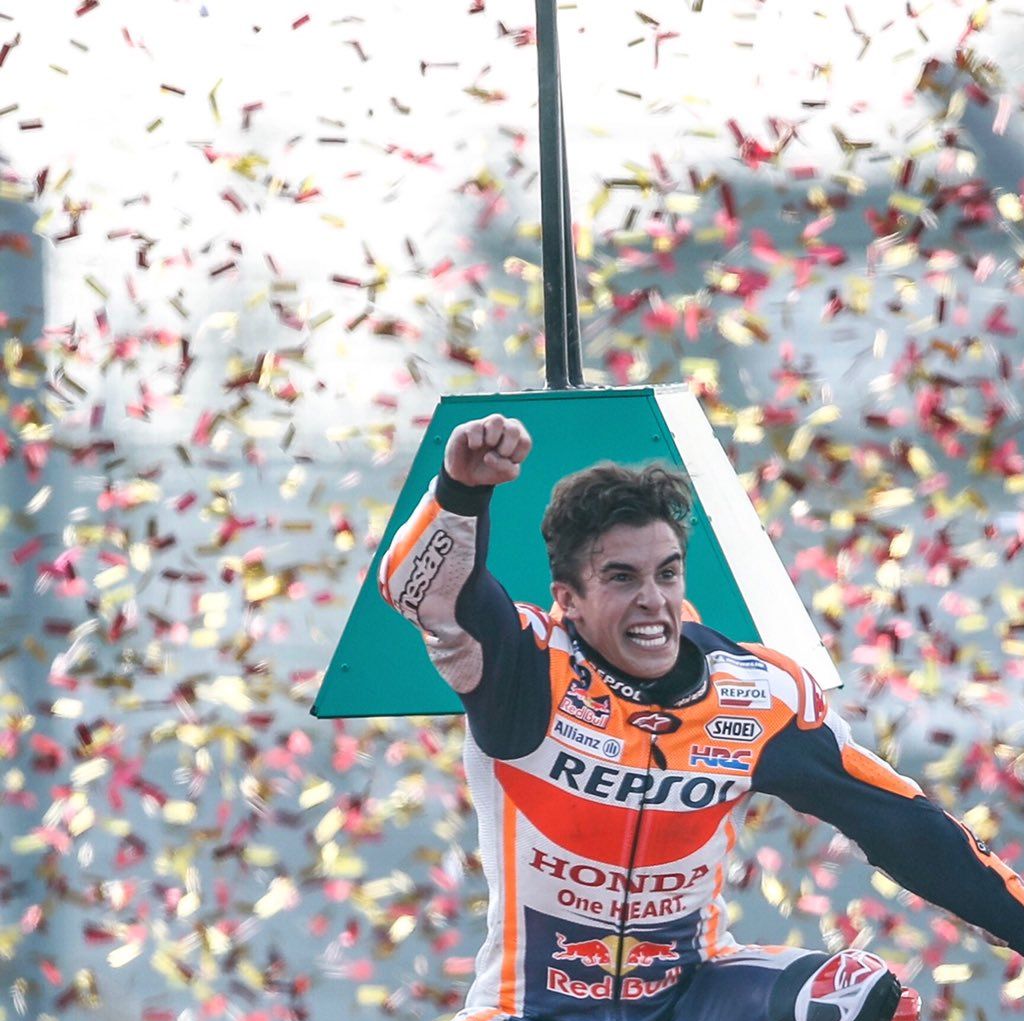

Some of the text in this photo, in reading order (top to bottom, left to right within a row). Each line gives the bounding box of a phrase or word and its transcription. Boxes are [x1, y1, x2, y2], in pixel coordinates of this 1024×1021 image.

[590, 662, 642, 702] EPSOL
[721, 688, 766, 699] REPSOL
[553, 719, 601, 750] Allianz
[713, 720, 755, 737] SHOEI
[690, 745, 752, 771] HRC
[529, 847, 710, 895] HONDA
[557, 888, 603, 915] One
[547, 966, 613, 1000] Red
